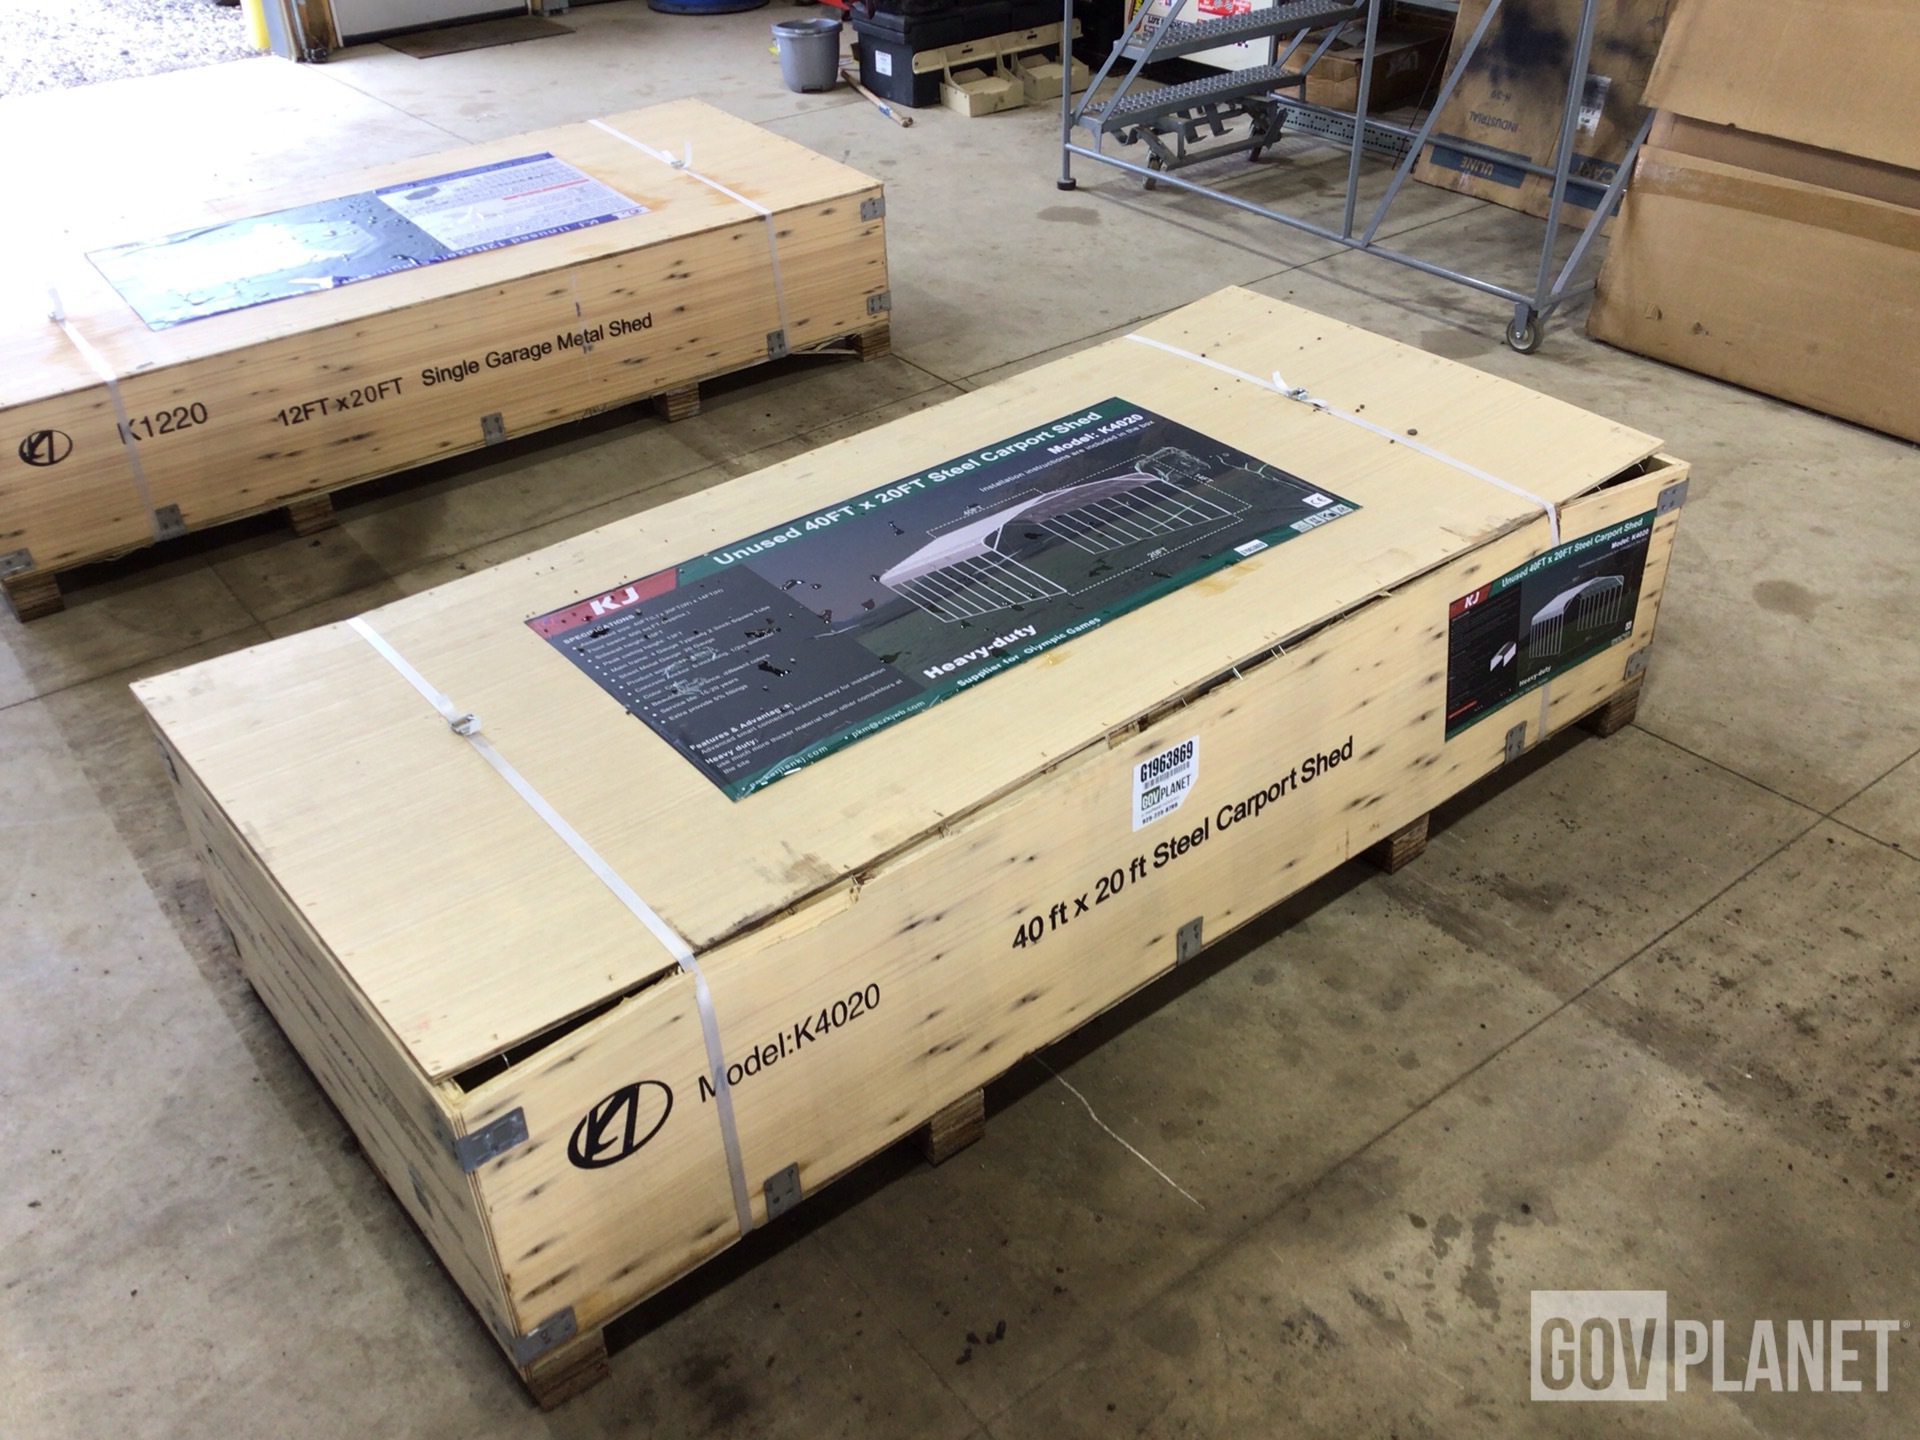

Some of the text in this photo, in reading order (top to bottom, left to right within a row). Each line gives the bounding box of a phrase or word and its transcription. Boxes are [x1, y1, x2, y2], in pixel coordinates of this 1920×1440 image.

[1469, 110, 1519, 133] INDUSTRIAL
[1460, 156, 1494, 176] ULINE
[421, 312, 653, 387] Single Garage Metal Shed
[116, 402, 208, 444] K1220
[277, 398, 330, 427] 12FT
[1045, 413, 1146, 454] Model: K4020
[976, 471, 1027, 492] Installation
[1022, 453, 1072, 474] instructions
[1082, 435, 1119, 450] included
[1137, 420, 1156, 428] box
[711, 411, 1105, 565] Unused 40FT x 20FT Steel Carport Shed
[1501, 567, 1528, 587] Unused
[1529, 557, 1546, 572] 40FT
[1554, 546, 1573, 561] 20FT
[1574, 537, 1594, 552] Steel
[1594, 526, 1623, 543] Carport
[1624, 517, 1643, 532] Shed
[590, 586, 639, 616] KJ
[1464, 591, 1480, 609] KJ
[562, 613, 636, 644] SPECIFICATIONS
[921, 622, 1041, 680] Heavy-duty
[955, 616, 1103, 687] Supplier for Olympic Games
[688, 730, 731, 751] Features
[737, 701, 795, 729] Advantags:
[699, 735, 737, 754] Advanced
[735, 726, 757, 737] smart
[755, 709, 796, 728] connecting
[793, 696, 824, 711] brackets
[822, 688, 842, 698] easy
[849, 667, 887, 685] installation
[703, 737, 760, 765] Heavy duty:
[1141, 740, 1193, 782] G1963869
[1012, 916, 1044, 950] 40
[1049, 902, 1068, 931] ft
[1074, 894, 1090, 921] x
[1095, 869, 1124, 905] 20
[1129, 856, 1147, 884] ft
[1152, 817, 1210, 869] Steel
[1216, 766, 1297, 831] Carport
[1300, 735, 1354, 783] Shed
[697, 983, 881, 1103] Model:K4020
